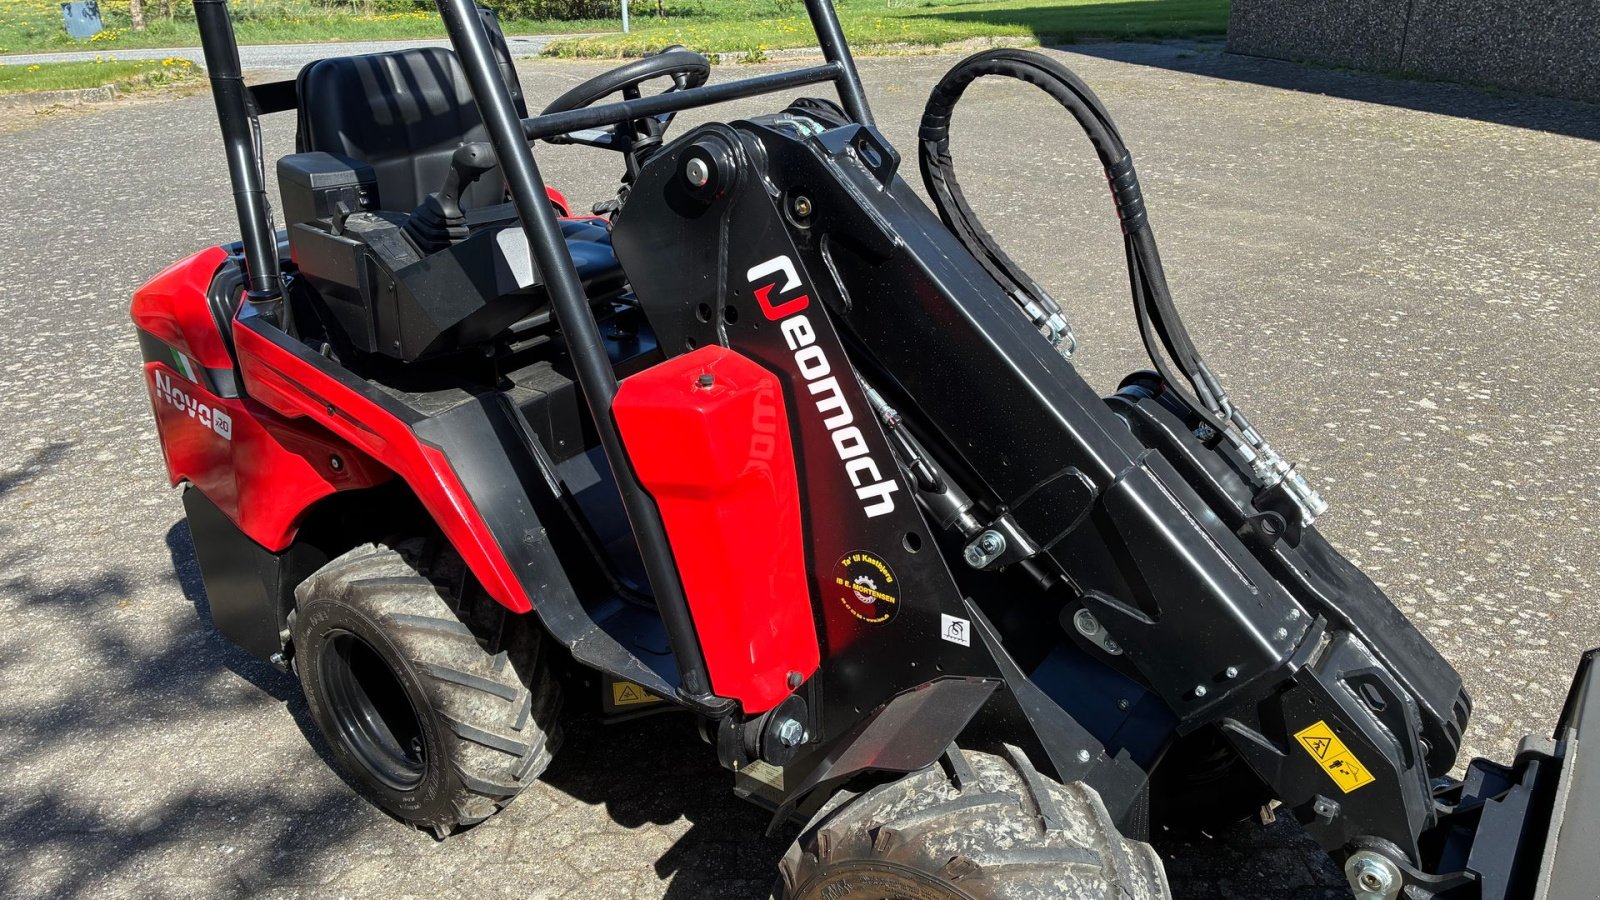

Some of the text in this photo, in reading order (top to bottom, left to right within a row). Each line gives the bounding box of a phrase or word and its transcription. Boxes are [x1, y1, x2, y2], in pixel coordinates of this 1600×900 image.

[155, 369, 212, 429] Nova
[747, 255, 899, 519] Neomach
[836, 577, 896, 604] IB E. MORTENSEN
[841, 554, 893, 583] Ta' til Kastbjerg
